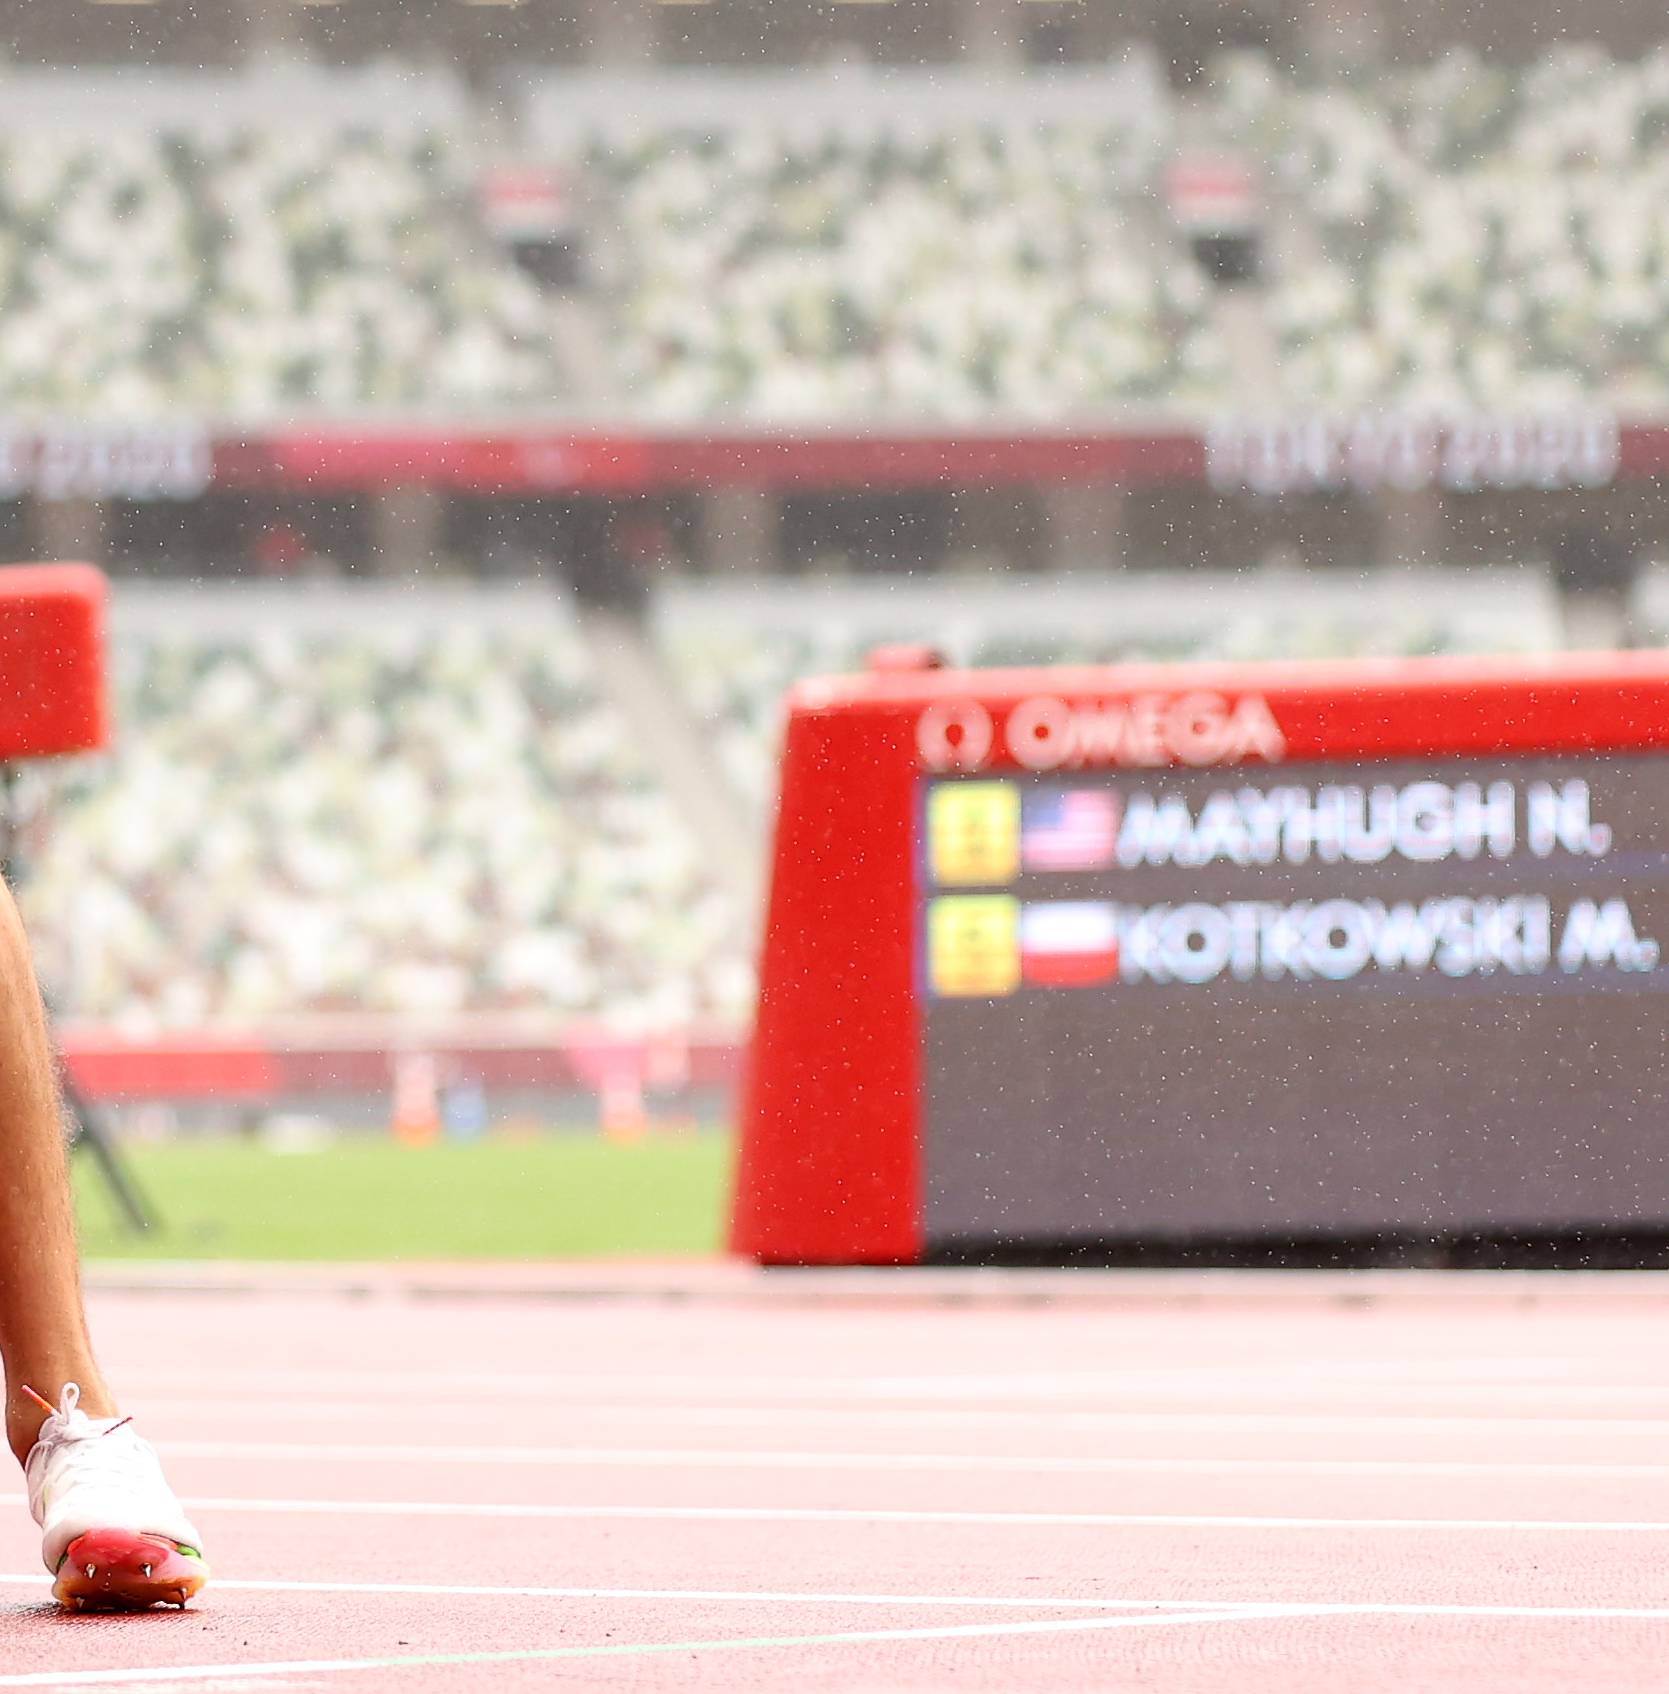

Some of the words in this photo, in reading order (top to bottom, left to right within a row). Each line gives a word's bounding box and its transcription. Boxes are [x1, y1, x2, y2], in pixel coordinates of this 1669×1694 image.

[1005, 692, 1286, 769] OMEGA
[1117, 782, 1518, 868] MAYHUGH
[1528, 778, 1614, 861] N.
[1119, 896, 1549, 984] KOTKOWSKI
[1559, 896, 1662, 973] M.
